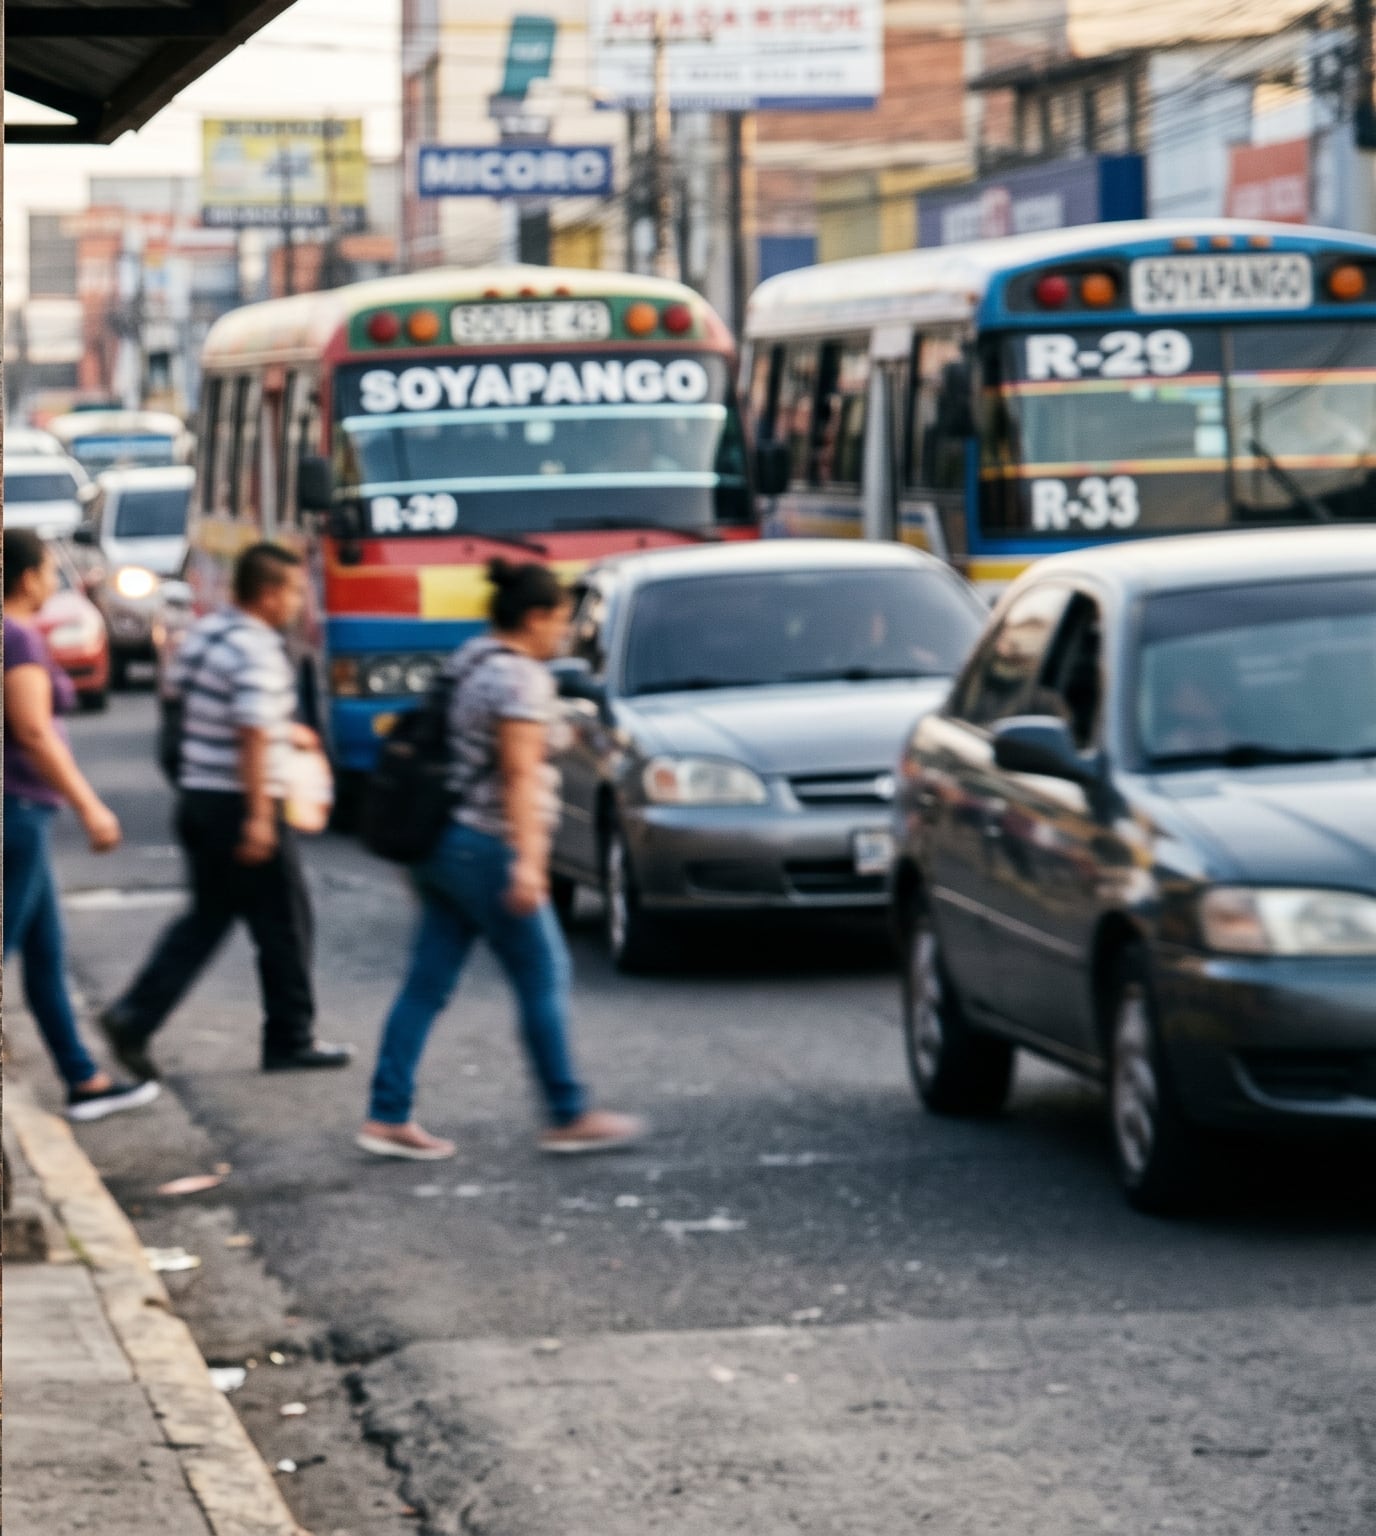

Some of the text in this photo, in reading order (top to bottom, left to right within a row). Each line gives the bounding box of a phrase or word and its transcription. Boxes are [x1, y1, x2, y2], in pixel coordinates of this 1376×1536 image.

[1144, 262, 1308, 304] SOYAPANGO
[1026, 329, 1193, 381] R-29
[359, 358, 708, 413] SOYAPANGO
[370, 493, 459, 533] R-29
[1032, 475, 1140, 531] R-33
